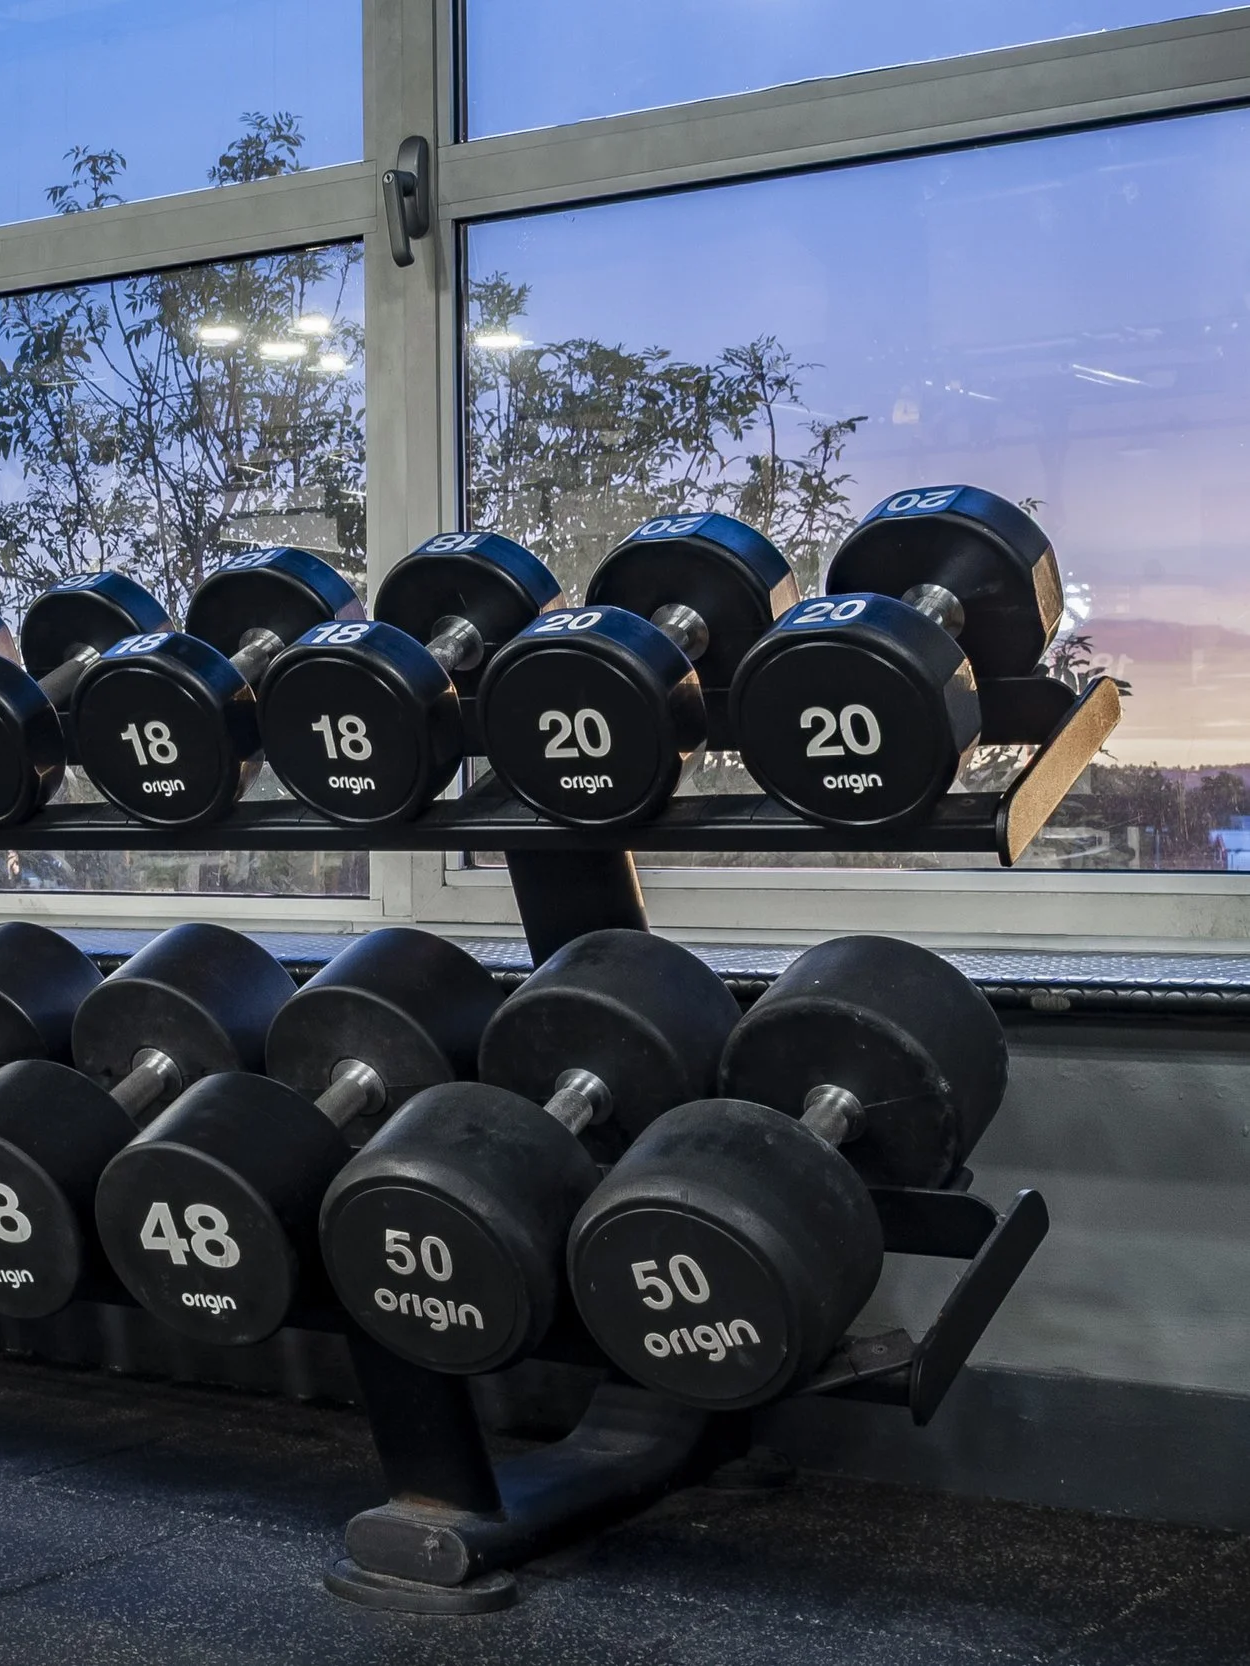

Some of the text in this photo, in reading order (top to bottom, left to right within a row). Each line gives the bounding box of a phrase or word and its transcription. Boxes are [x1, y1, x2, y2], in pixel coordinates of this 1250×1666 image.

[535, 612, 602, 632] 20
[793, 600, 867, 622] 20
[115, 633, 168, 654] 18
[314, 624, 370, 644] 18
[121, 721, 177, 765] 18
[312, 715, 372, 760] 18
[539, 709, 611, 758] 20
[800, 704, 881, 757] 20
[143, 780, 185, 796] origin
[329, 777, 375, 794] origin
[561, 776, 613, 793] origin
[823, 774, 882, 793] origin
[140, 1202, 240, 1268] 48
[386, 1229, 452, 1281] 50
[631, 1255, 709, 1309] 50
[182, 1293, 236, 1314] origin
[375, 1288, 483, 1331] origin
[645, 1319, 760, 1361] origin
